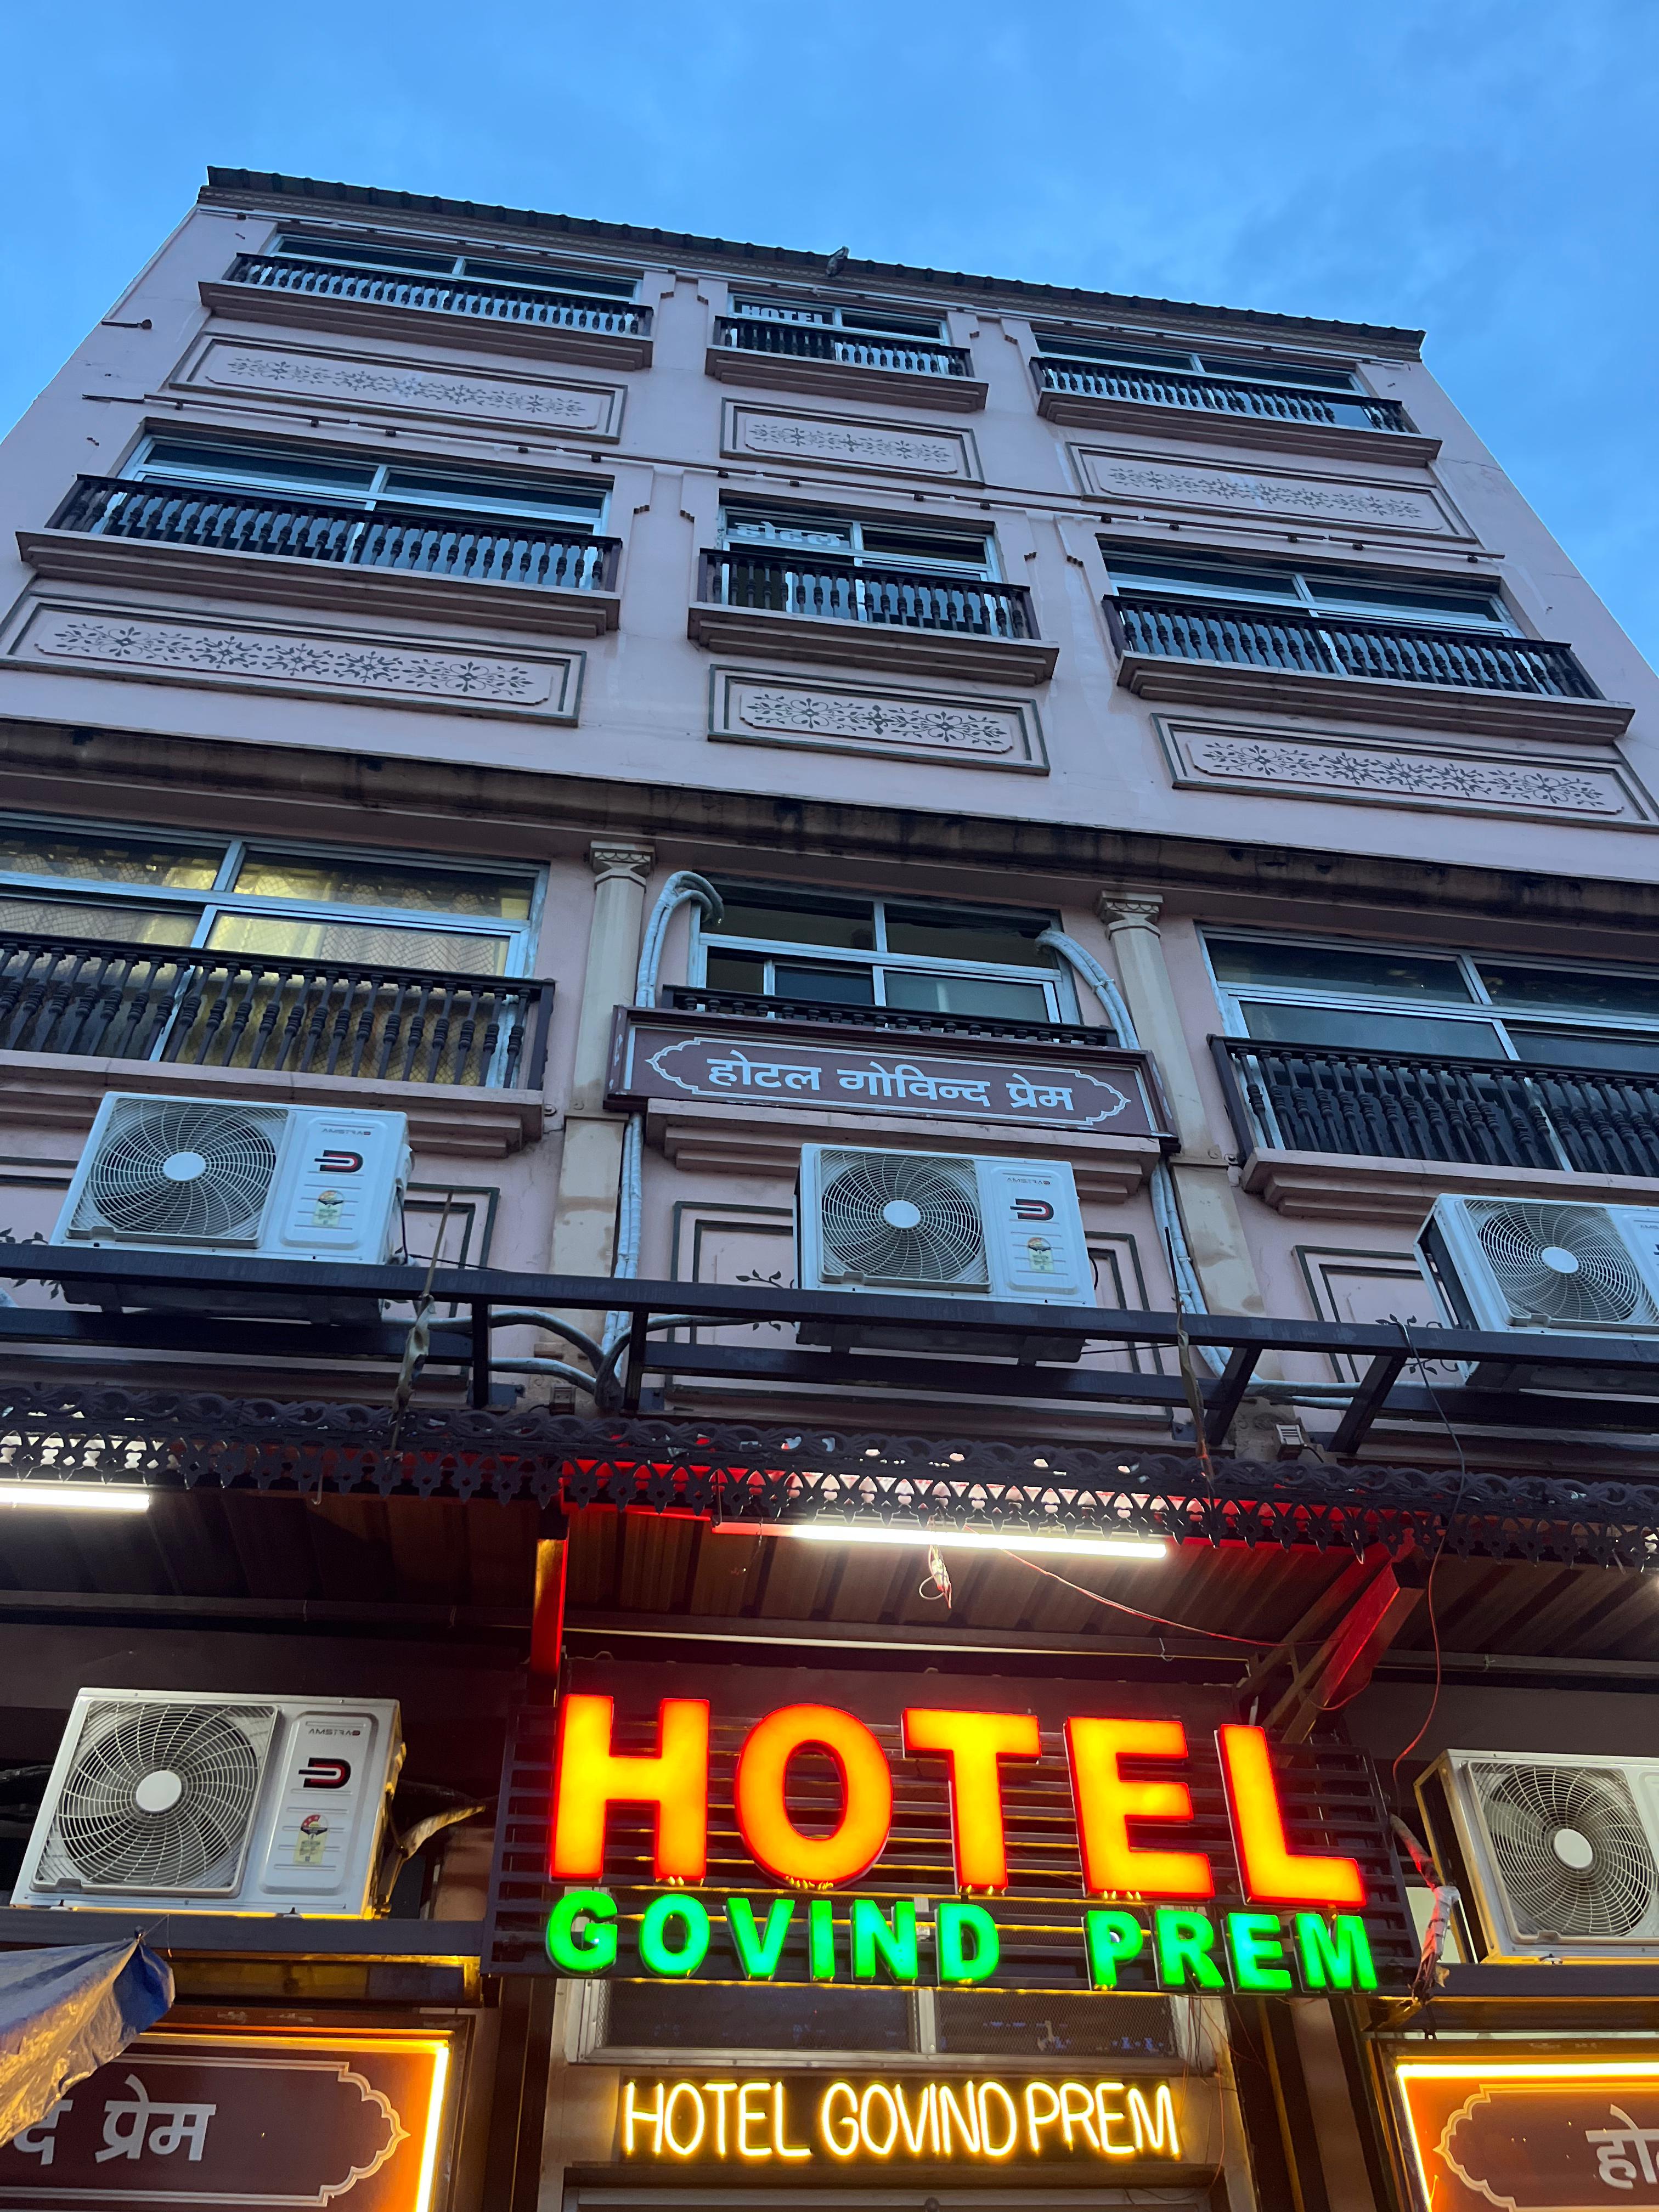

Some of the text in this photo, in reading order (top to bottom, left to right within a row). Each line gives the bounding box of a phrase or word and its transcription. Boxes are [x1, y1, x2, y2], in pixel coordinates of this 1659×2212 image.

[734, 521, 844, 546] होटल
[707, 1049, 1074, 1110] होटल गोविन्द प्रेम
[550, 1694, 1366, 1908] HOTEL
[546, 1890, 1378, 1994] GOVIND PREM
[95, 2074, 216, 2163] प्रेम
[624, 2081, 1181, 2159] HOTEL GOVIND PREM
[1585, 2104, 1659, 2190] हो
